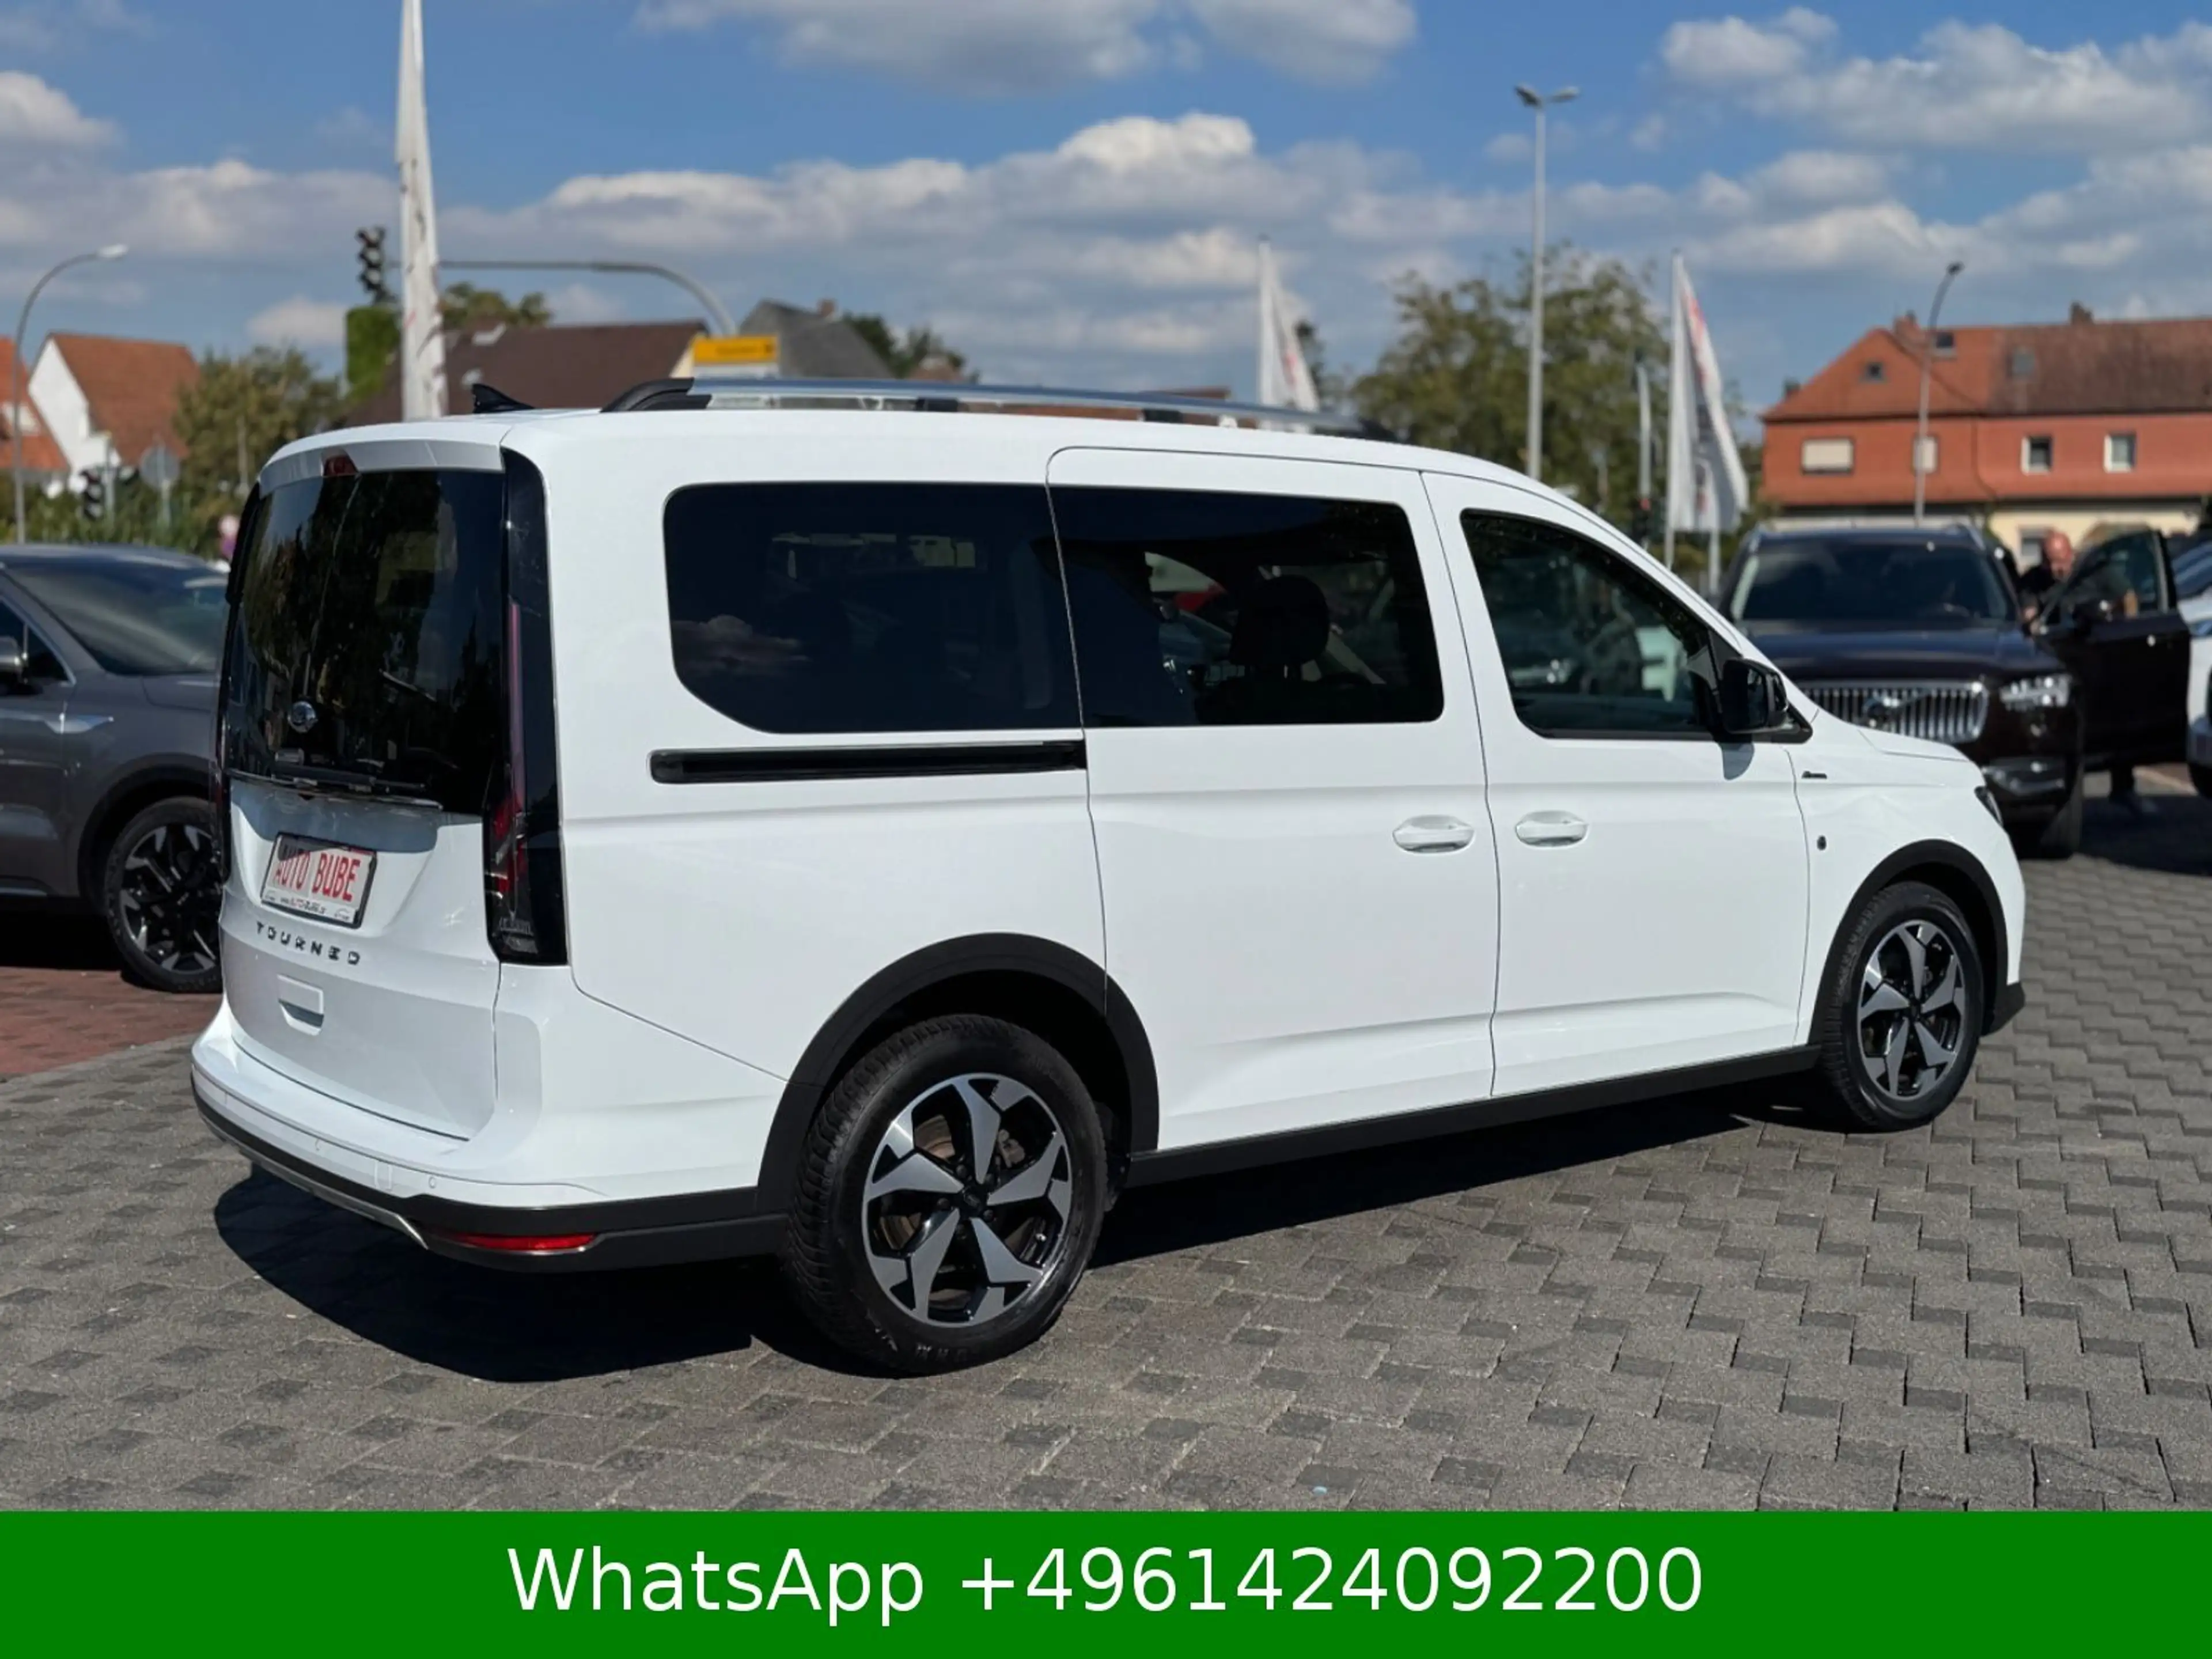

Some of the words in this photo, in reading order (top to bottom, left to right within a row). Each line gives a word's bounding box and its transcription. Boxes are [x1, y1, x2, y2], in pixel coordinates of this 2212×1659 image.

[274, 844, 311, 890] AUTO
[312, 853, 361, 902] BUBE
[256, 921, 361, 965] TOURNEO
